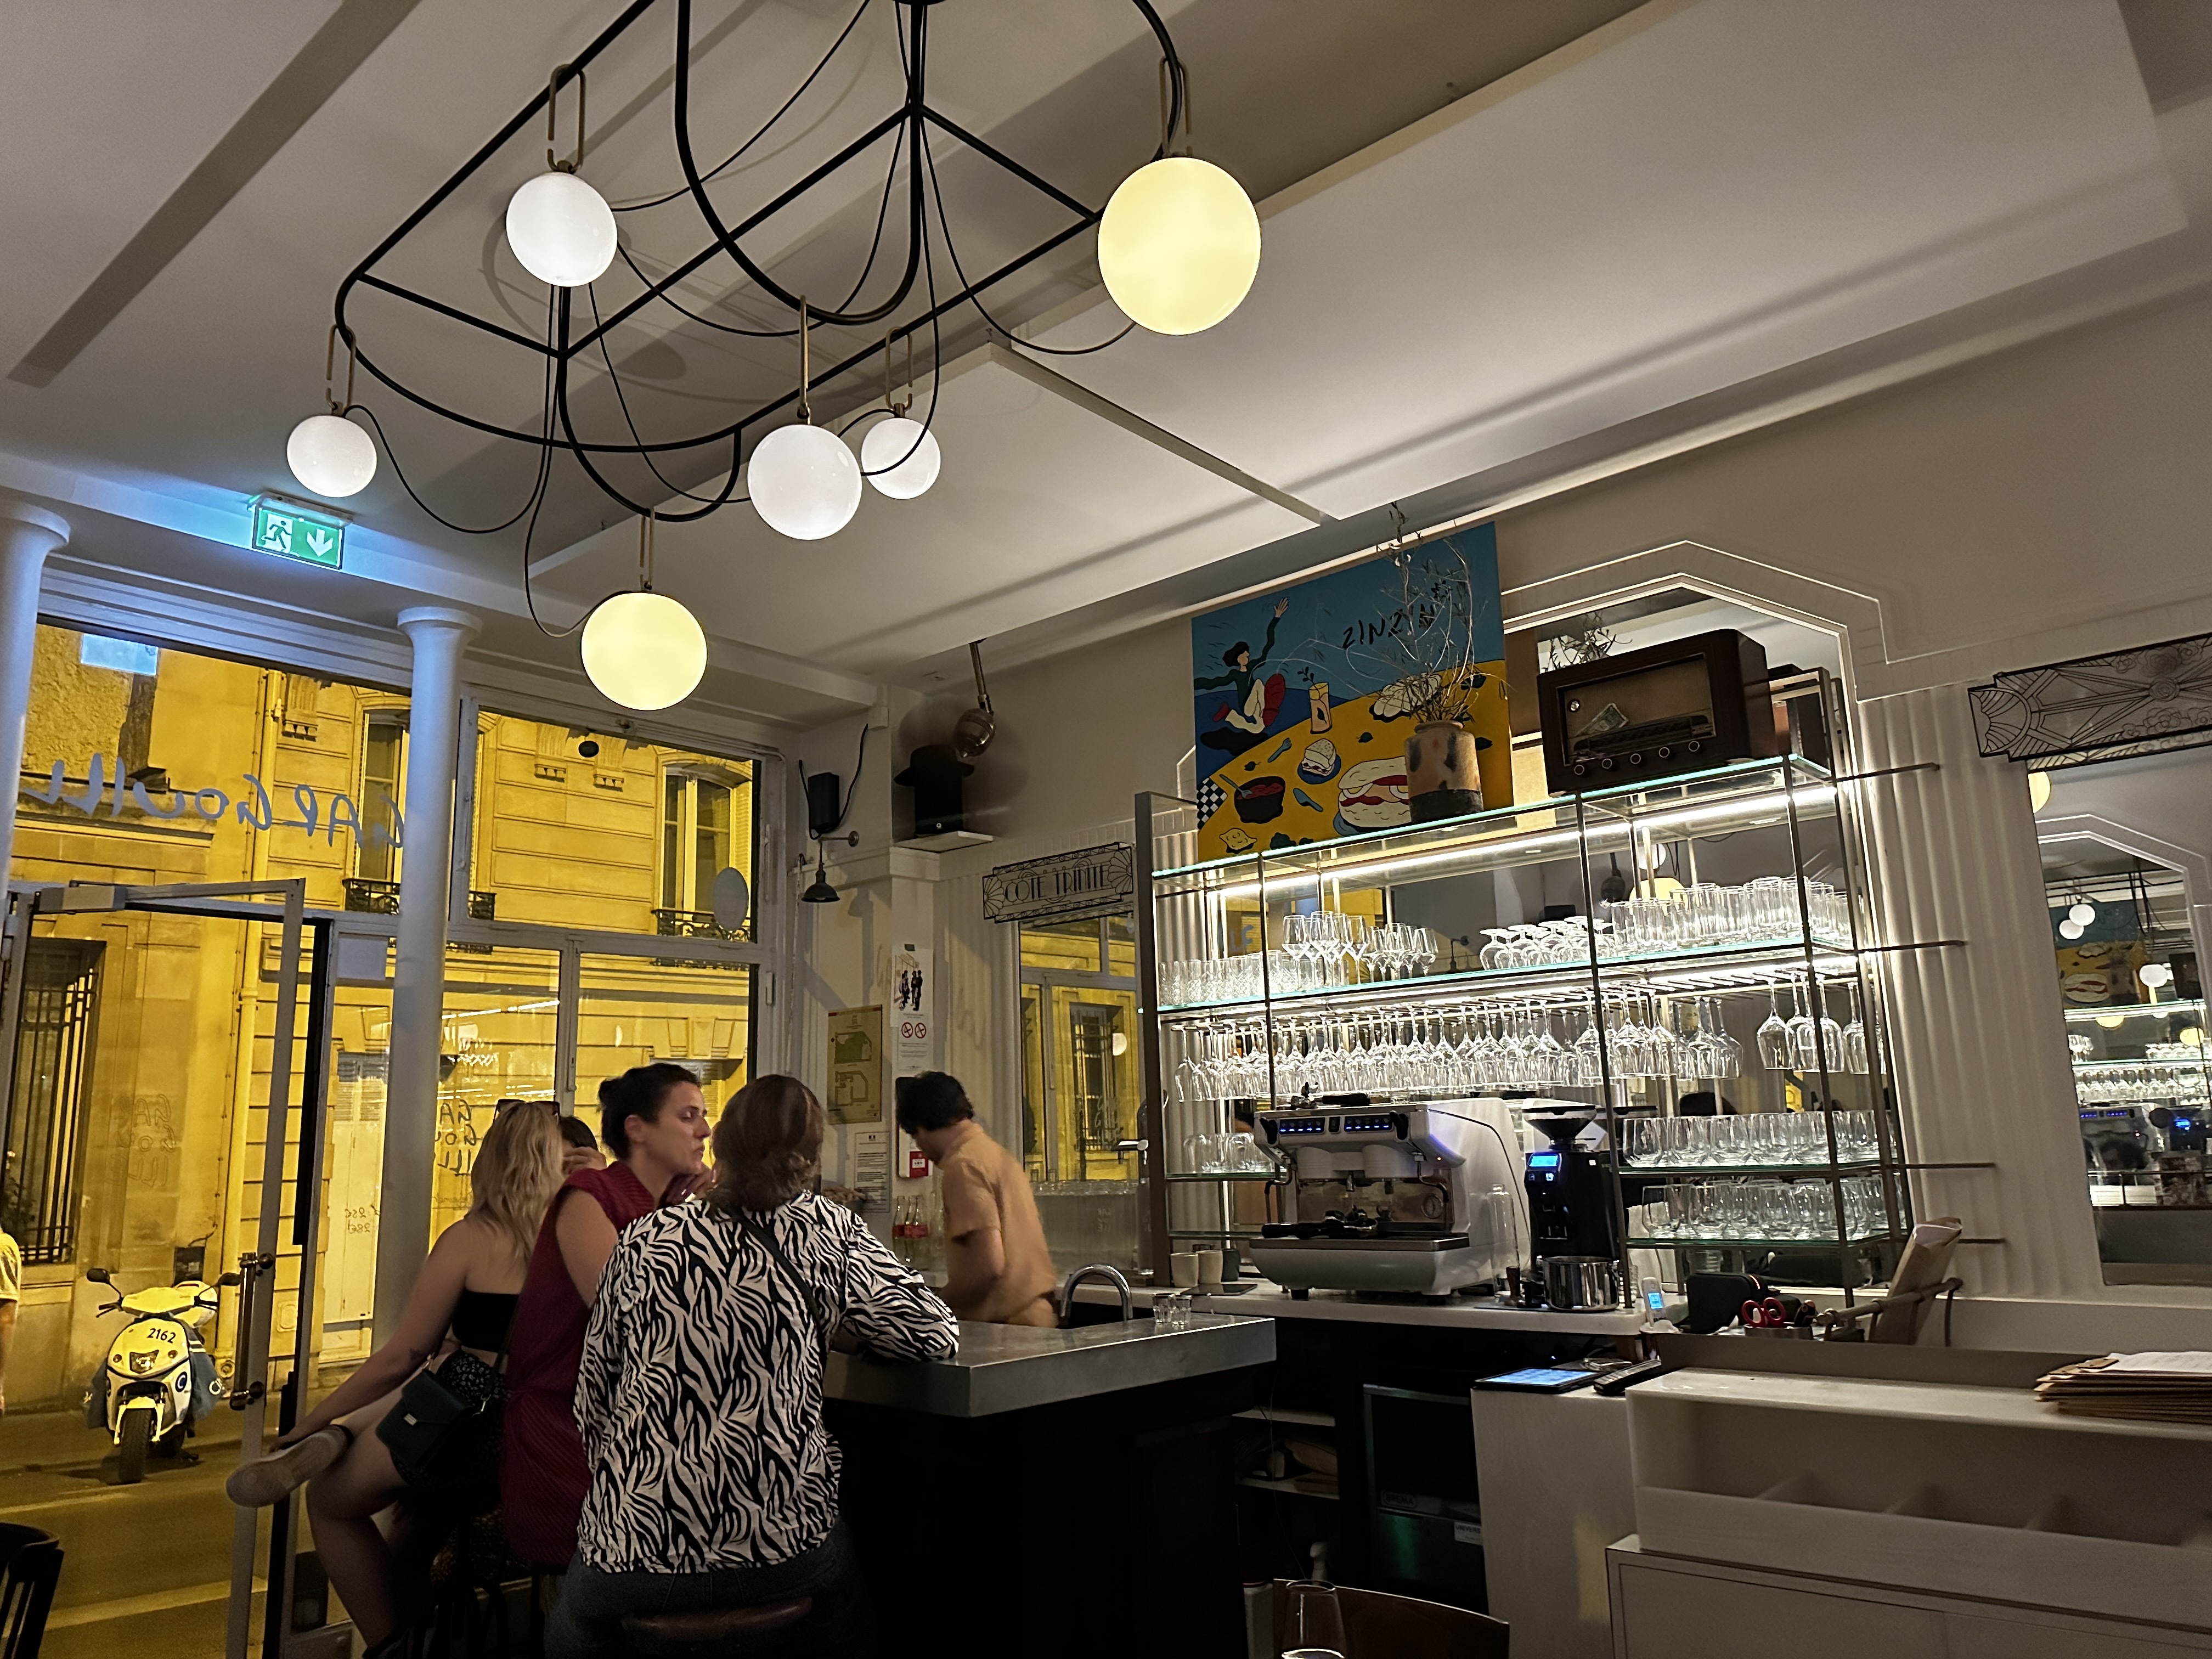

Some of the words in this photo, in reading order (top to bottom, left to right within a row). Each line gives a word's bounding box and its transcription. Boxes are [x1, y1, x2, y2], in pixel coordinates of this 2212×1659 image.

[1053, 864, 1111, 895] TRINITE
[146, 1328, 177, 1344] 2162
[1386, 1494, 1414, 1505] BREMA
